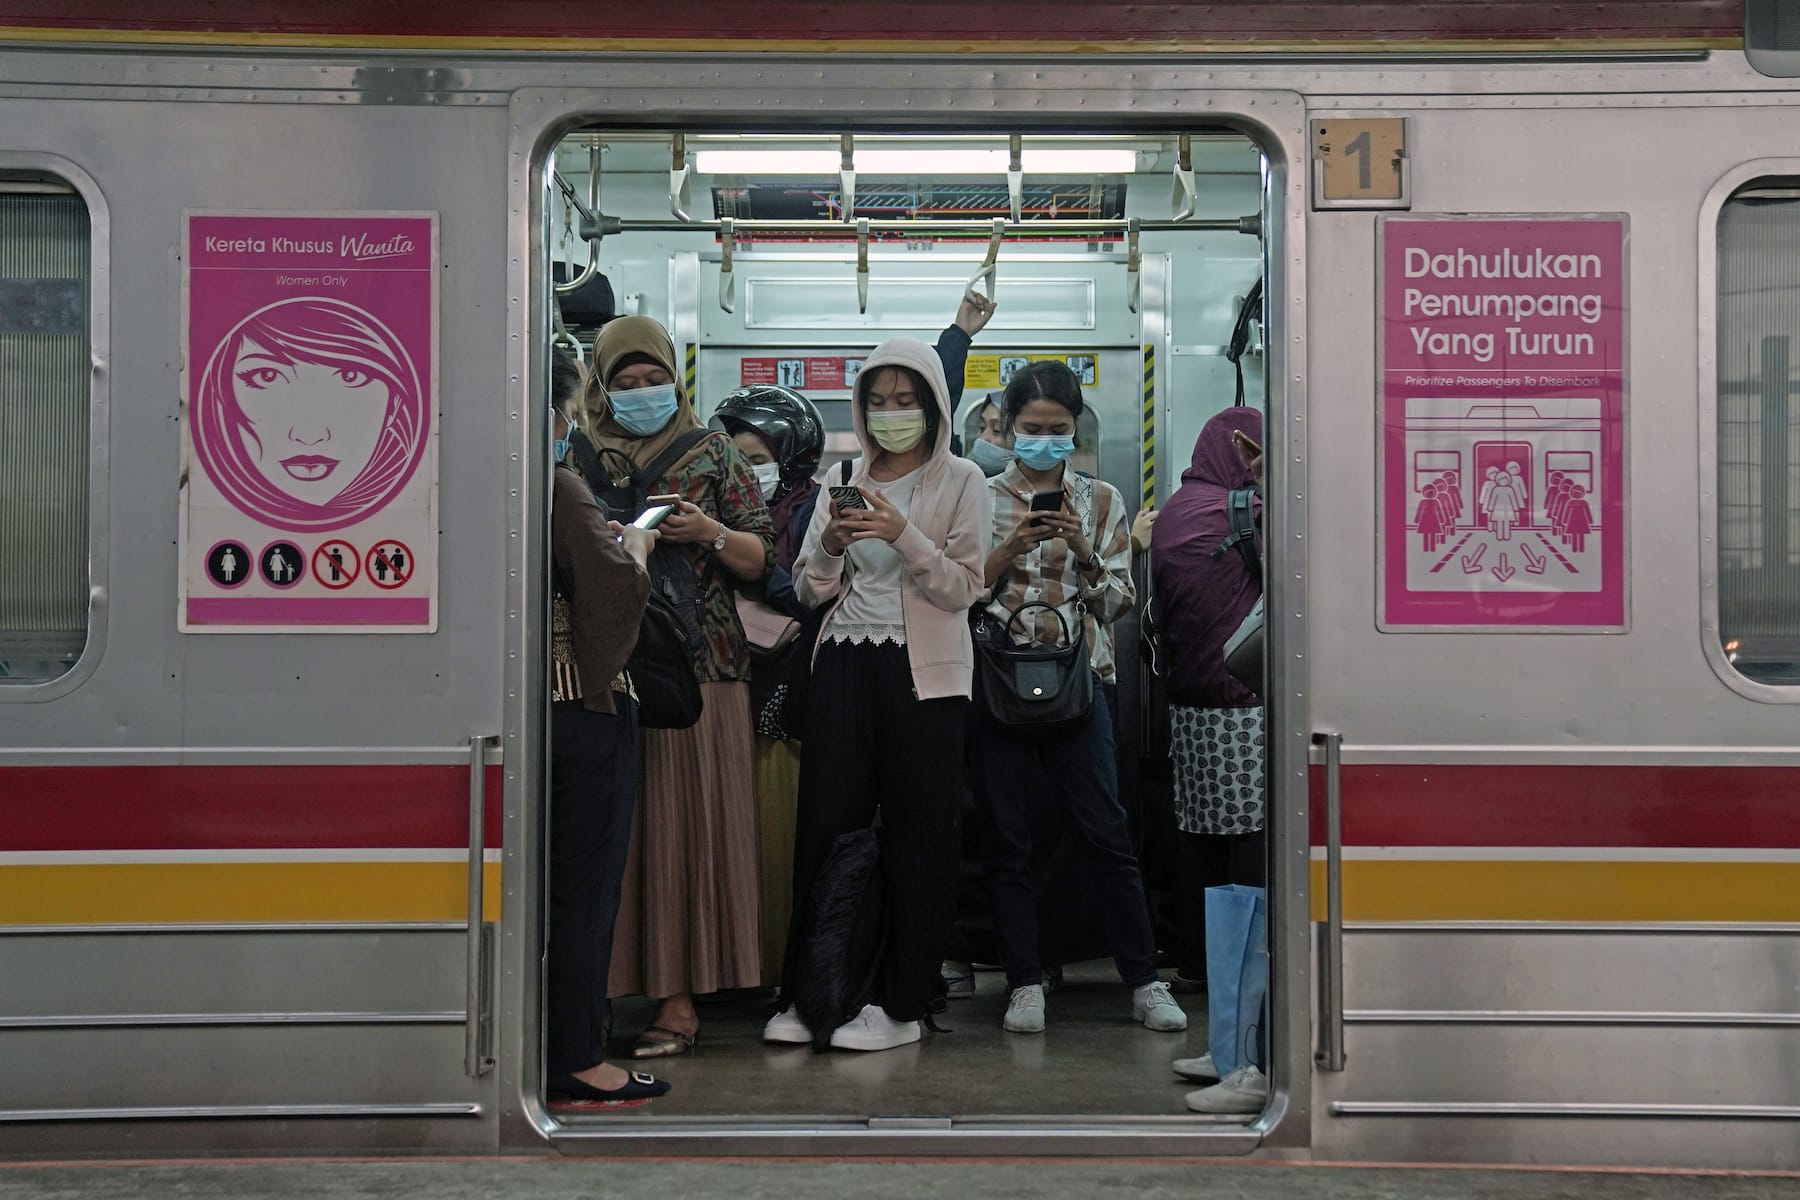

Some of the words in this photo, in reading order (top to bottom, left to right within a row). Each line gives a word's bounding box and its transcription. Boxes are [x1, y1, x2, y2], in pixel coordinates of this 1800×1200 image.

[1345, 132, 1371, 189] 1
[205, 236, 265, 253] Kereta
[272, 236, 334, 253] Khusus
[340, 232, 415, 258] Wanita
[1404, 247, 1601, 279] Dahulukan
[275, 275, 319, 286] Women
[322, 275, 349, 288] Only
[1404, 288, 1602, 324] Penumpang
[1409, 327, 1495, 362] Yang
[1504, 327, 1594, 355] Turun
[1404, 375, 1454, 387] Prioritize
[1456, 375, 1521, 389] Passengers
[1524, 375, 1537, 387] To
[1539, 375, 1601, 387] Disembark
